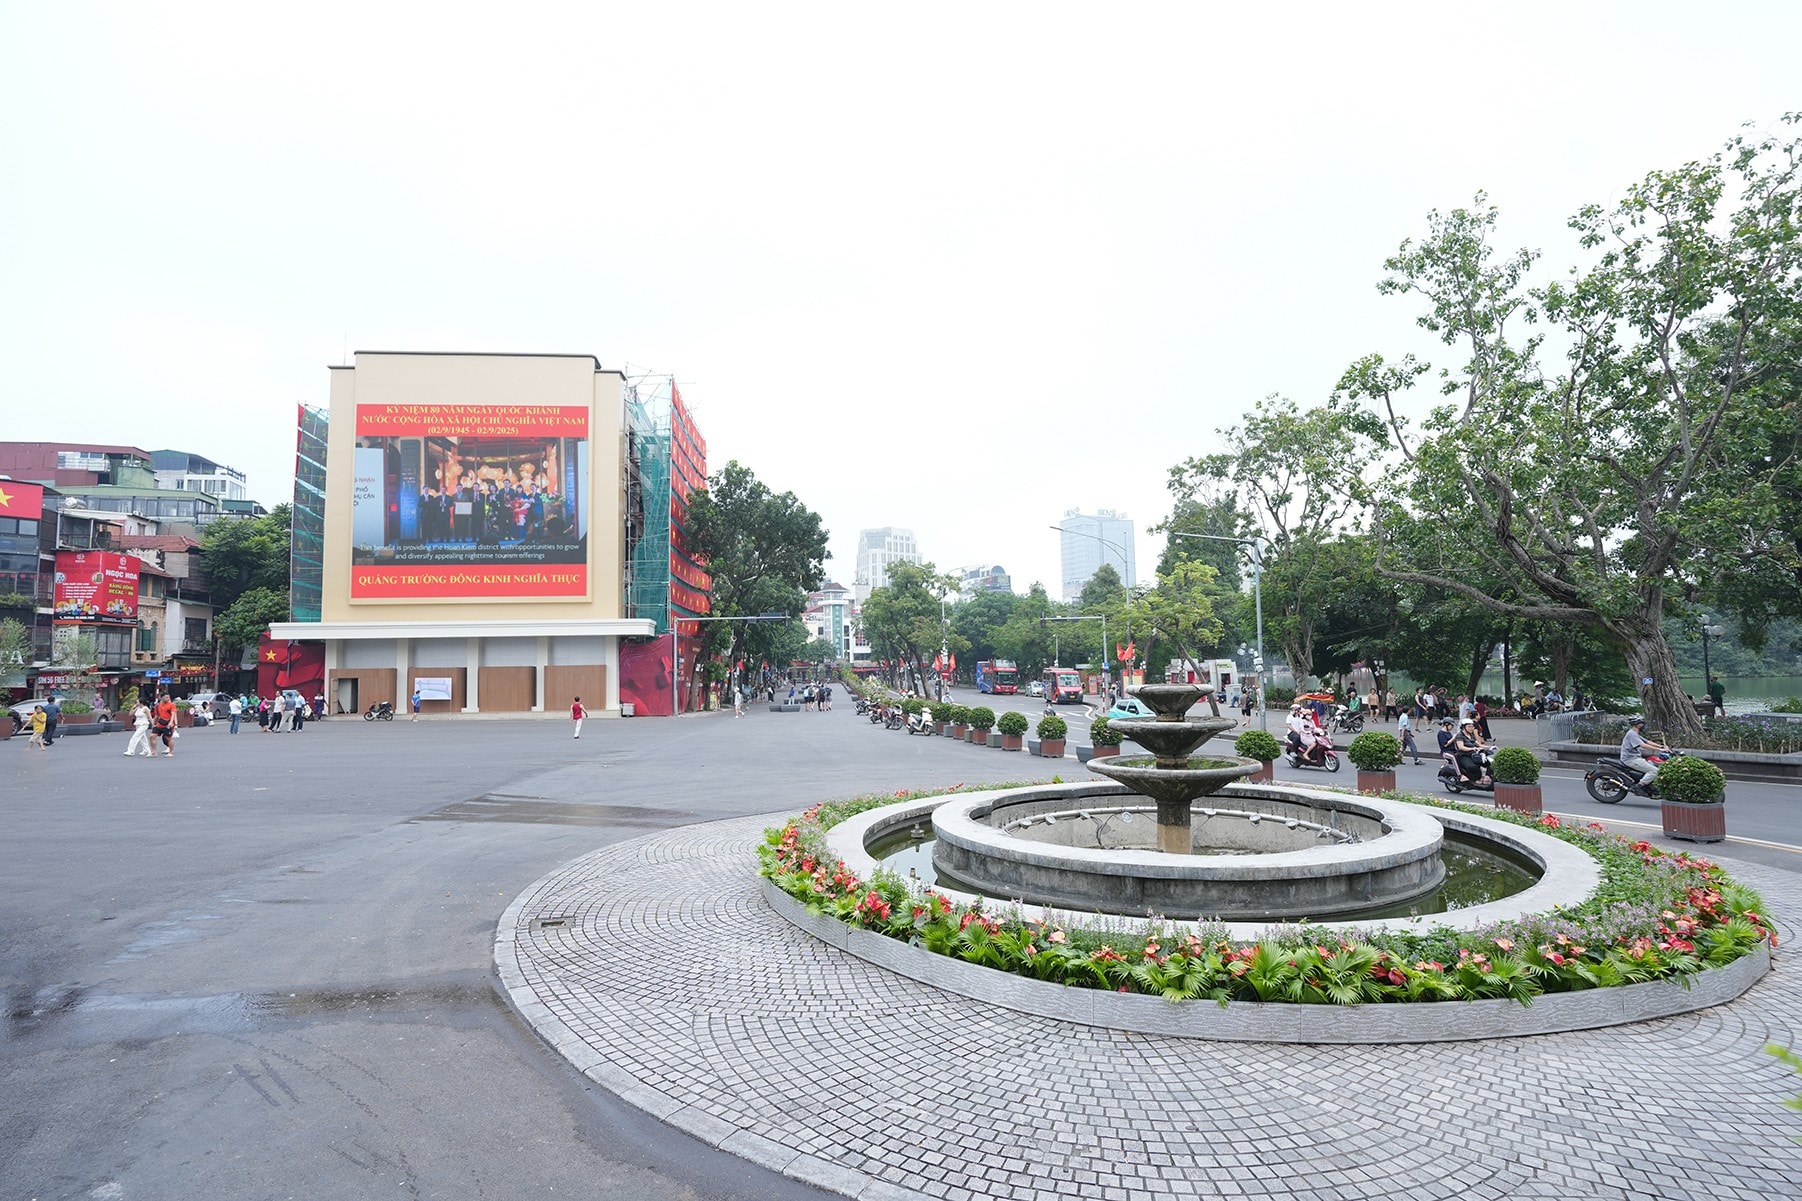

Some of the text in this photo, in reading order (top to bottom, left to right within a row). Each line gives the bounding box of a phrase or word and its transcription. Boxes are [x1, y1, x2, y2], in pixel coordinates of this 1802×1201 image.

[430, 406, 440, 414] 80
[362, 414, 585, 426] NƯỚC CỘNG HÒA XÃ HỘI CHỦ NGHĨA VIỆT NAM
[428, 426, 470, 435] (02/9/1945
[477, 426, 519, 436] 02/9/2025)
[402, 544, 431, 552] providing
[514, 544, 556, 552] opportunities
[434, 553, 464, 561] appealing
[464, 553, 494, 561] nighttime
[518, 552, 546, 560] offerings
[106, 569, 124, 578] NGỌC
[358, 573, 580, 586] QUẢNG TRƯỜNG ĐÔNG KINH NGHĨA THỤC
